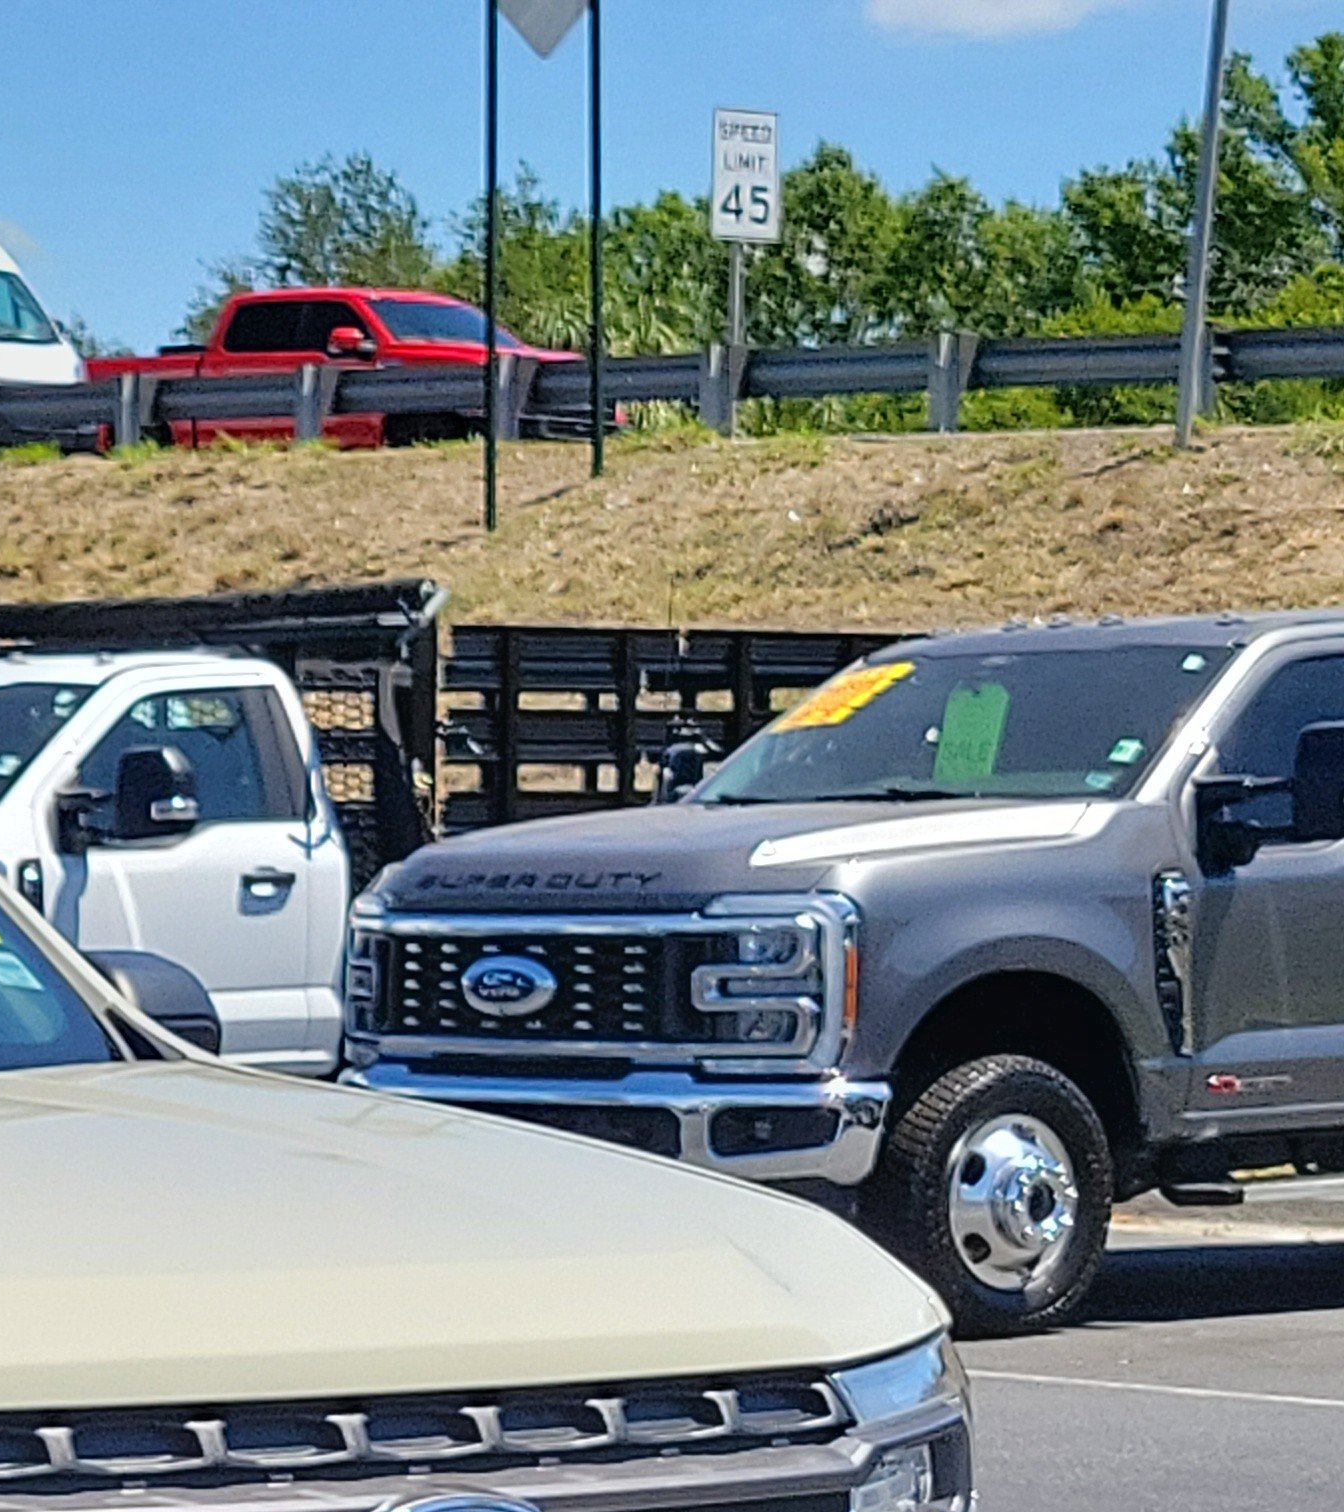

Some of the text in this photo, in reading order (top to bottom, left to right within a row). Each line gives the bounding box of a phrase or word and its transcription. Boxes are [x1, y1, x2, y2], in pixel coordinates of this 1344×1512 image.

[719, 121, 772, 144] SPEED
[723, 151, 769, 173] LIMIT
[720, 184, 770, 224] 45
[415, 870, 662, 890] SUPER DUTY
